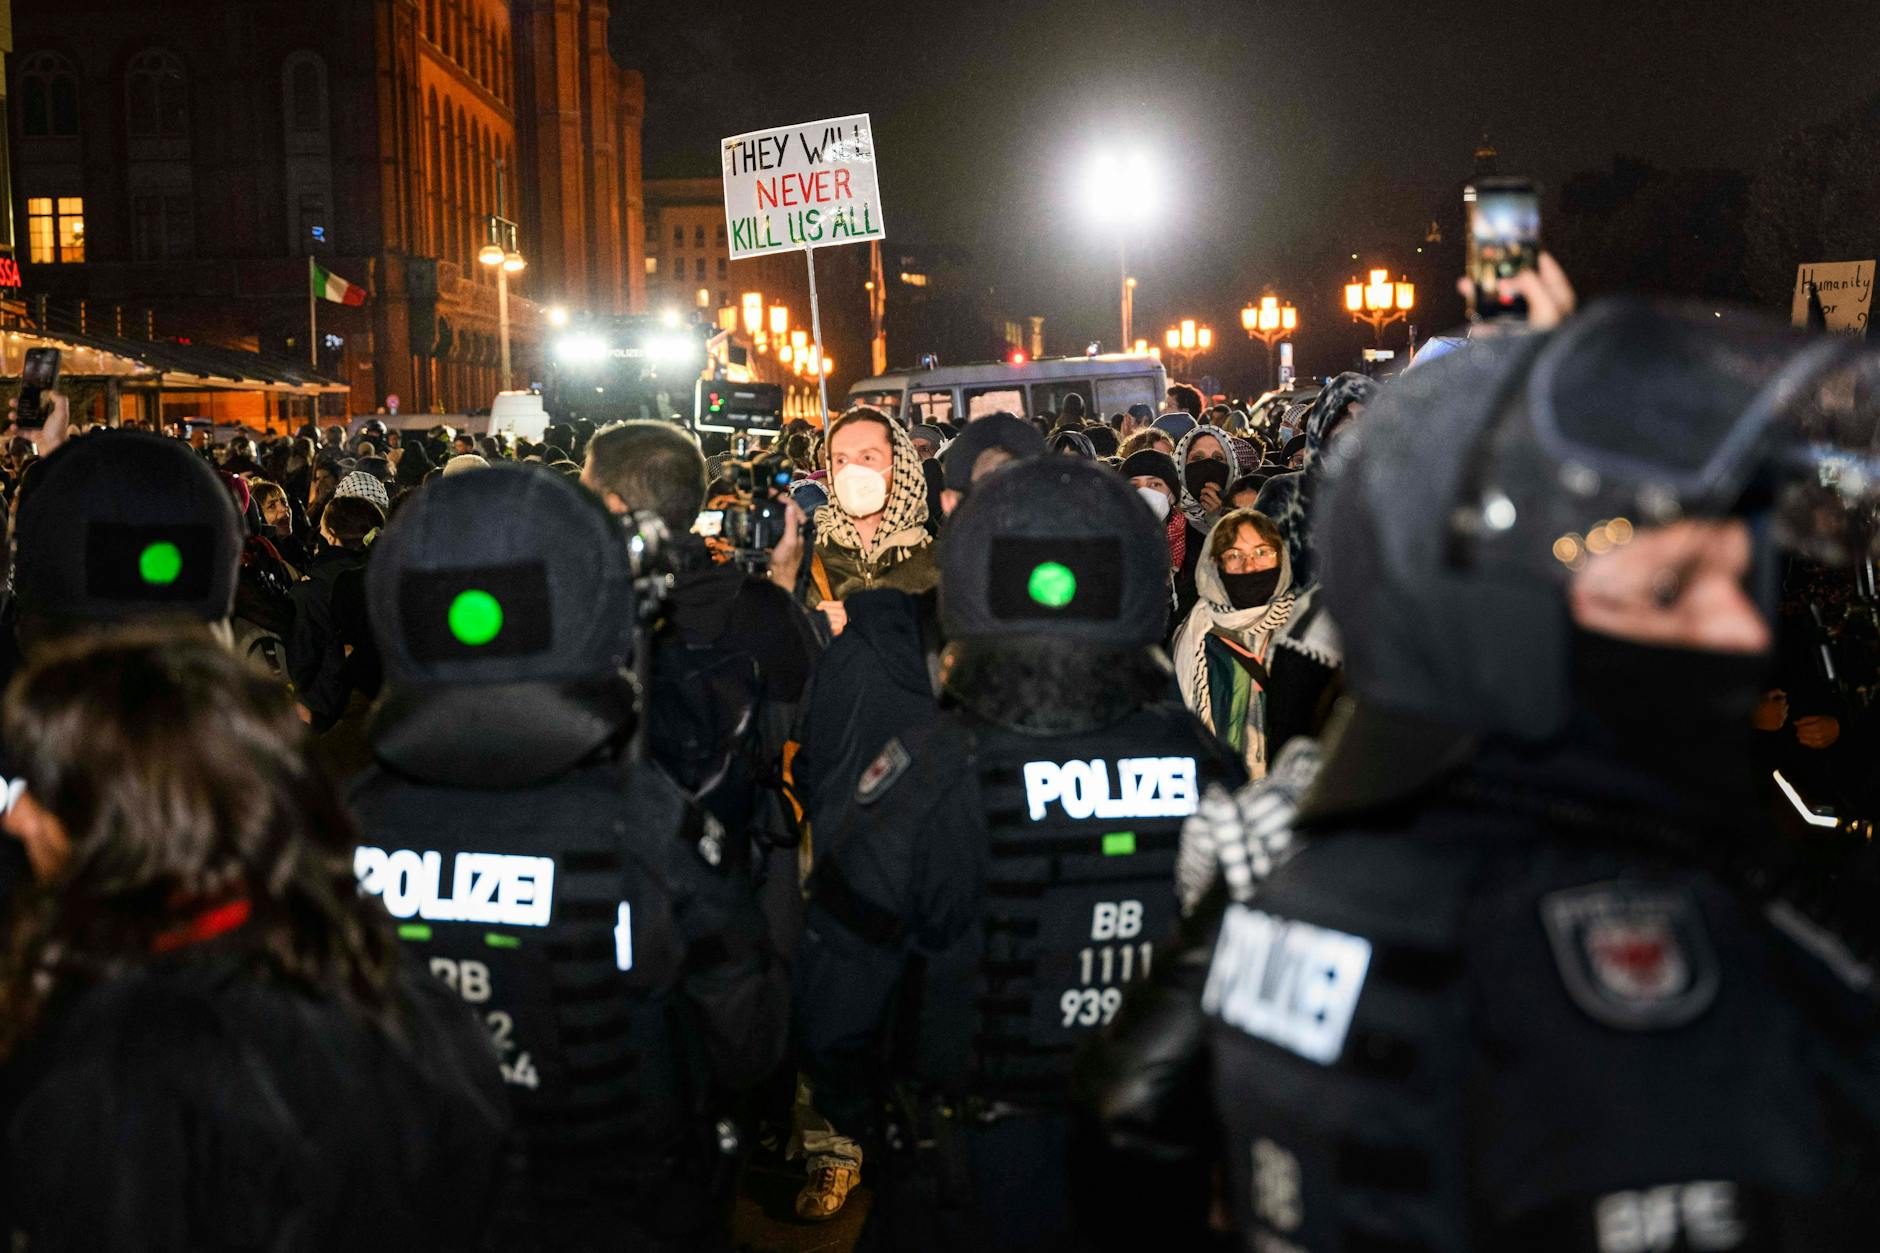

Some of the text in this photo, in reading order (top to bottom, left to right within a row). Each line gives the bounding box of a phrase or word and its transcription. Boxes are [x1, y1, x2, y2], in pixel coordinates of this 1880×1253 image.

[725, 124, 872, 176] THEY WILL
[756, 168, 852, 210] NEVER
[732, 202, 879, 251] KILL US ALL
[1023, 756, 1199, 820] POLIZEI
[353, 846, 555, 927] POLIZEI
[1091, 900, 1143, 941] BB
[1060, 987, 1122, 1028] 939
